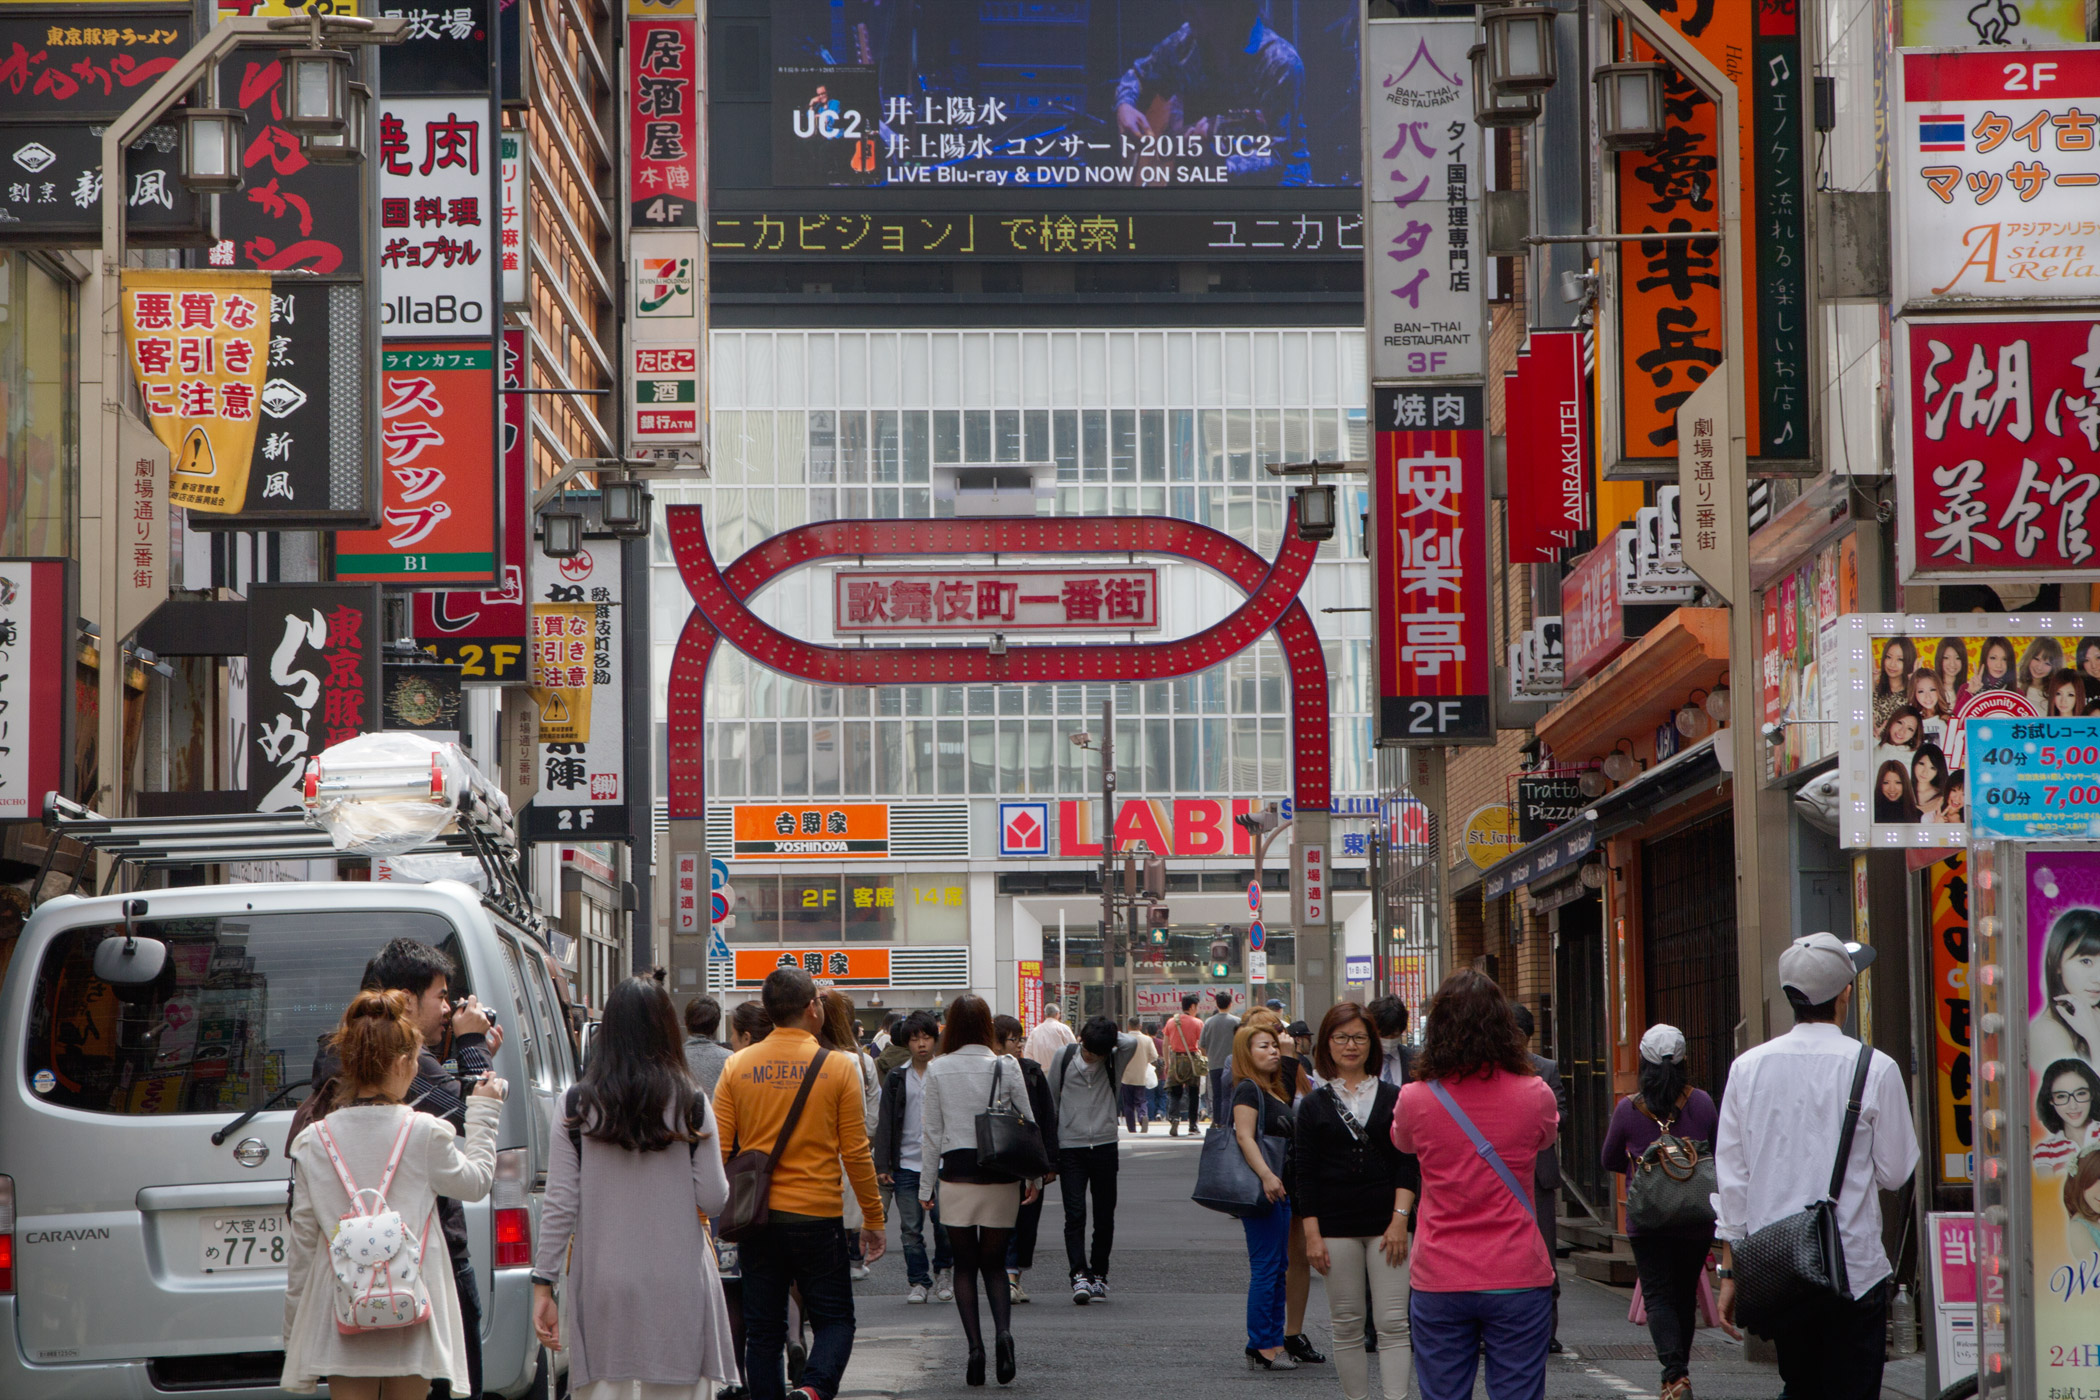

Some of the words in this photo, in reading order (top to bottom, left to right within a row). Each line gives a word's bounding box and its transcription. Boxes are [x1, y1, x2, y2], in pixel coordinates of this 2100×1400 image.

[46, 26, 179, 46] 東京豚骨ラーメン
[2002, 62, 2059, 92] 2F
[637, 29, 687, 162] 居酒屋
[1386, 90, 1461, 108] RESTAURANT
[1395, 86, 1452, 100] BAN-THAI
[793, 109, 862, 138] UC2
[884, 96, 1008, 126] 井上陽水
[1971, 106, 2100, 154] タイ古
[884, 133, 994, 160] 井上陽水
[1006, 134, 1203, 160] コンサート2015
[1214, 134, 1273, 158] UC2
[639, 165, 690, 190] 本陣
[886, 165, 931, 183] LIVE
[937, 165, 1008, 187] Blu-ray
[1014, 166, 1031, 183] &
[1036, 165, 1080, 183] DVD
[1085, 165, 1134, 183] NOW
[1140, 165, 1170, 183] ON
[1176, 165, 1228, 183] SALE
[1920, 160, 2100, 206] マッサー
[8, 183, 58, 204] 割烹
[1447, 120, 1471, 293] タイ国料理専門店
[501, 164, 520, 271] リーチ麻雀
[645, 198, 684, 223] 4F
[1381, 120, 1438, 310] バンタイ
[380, 237, 482, 269] ギョプサル
[134, 291, 258, 331] 悪質な
[1383, 334, 1472, 347] RESTAURANT
[1393, 321, 1462, 333] BAN-THAI
[136, 336, 257, 376] 客引き
[636, 350, 696, 374] たばこ
[1407, 351, 1448, 373] 3F
[141, 380, 257, 422] に注意
[652, 381, 680, 402] 酒
[639, 412, 694, 431] 銀行ATM
[1393, 393, 1466, 427] 焼肉
[259, 431, 296, 501] 新風
[382, 375, 452, 549] ステップ
[1559, 400, 1583, 524] ANRAKUTEI
[1692, 417, 1718, 551] 劇場通り一番街
[169, 491, 225, 506] 商店街振興組合
[132, 457, 156, 590] 劇場通り一番街
[403, 555, 427, 571] B1
[1397, 450, 1467, 676] 安楽亭
[847, 577, 1147, 624] 歌舞伎町一番街
[1408, 700, 1462, 734] 2F
[2011, 723, 2099, 740] お試しコース
[518, 710, 532, 787] 劇場通り一番街
[1982, 747, 2028, 766] 40分
[1985, 787, 2031, 806] 60分
[557, 809, 595, 831] 2F
[775, 810, 849, 835] 吉野家
[1059, 799, 1260, 857] LABI
[774, 840, 849, 853] YOSHINOYA
[680, 858, 694, 928] 劇場通り
[802, 889, 836, 907] 2F
[853, 887, 895, 908] 客席
[1307, 849, 1322, 919] 劇場通り
[1205, 986, 1245, 1005] Sle
[25, 1226, 110, 1245] CARAVAN
[225, 1217, 256, 1234] 大宮
[205, 1246, 220, 1260] め
[222, 1235, 289, 1266] 77-8
